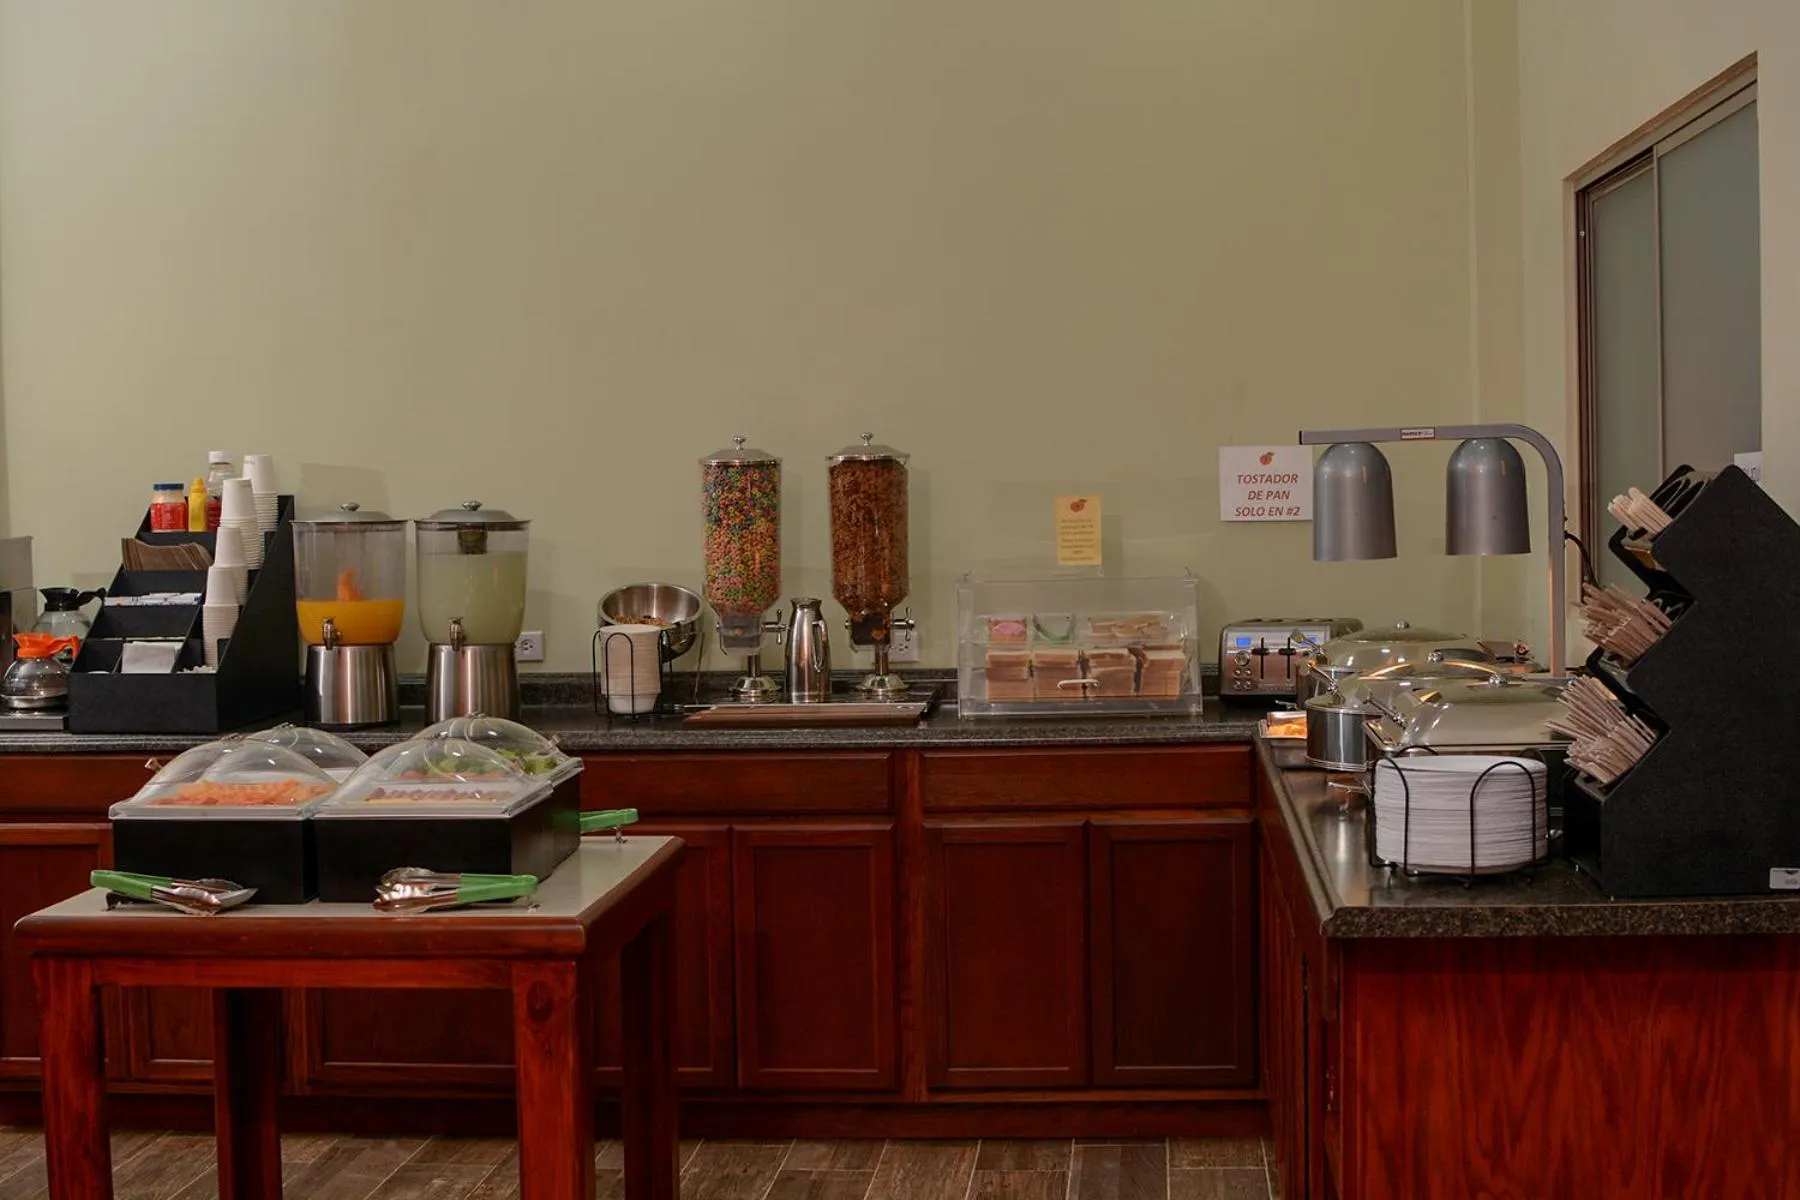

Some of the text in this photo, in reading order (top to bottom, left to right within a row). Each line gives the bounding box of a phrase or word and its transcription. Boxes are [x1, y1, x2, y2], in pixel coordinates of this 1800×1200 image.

[1237, 474, 1298, 484] TOSTADOR
[1247, 490, 1290, 500] DE PAN
[1235, 507, 1300, 517] SOLO EN #2
